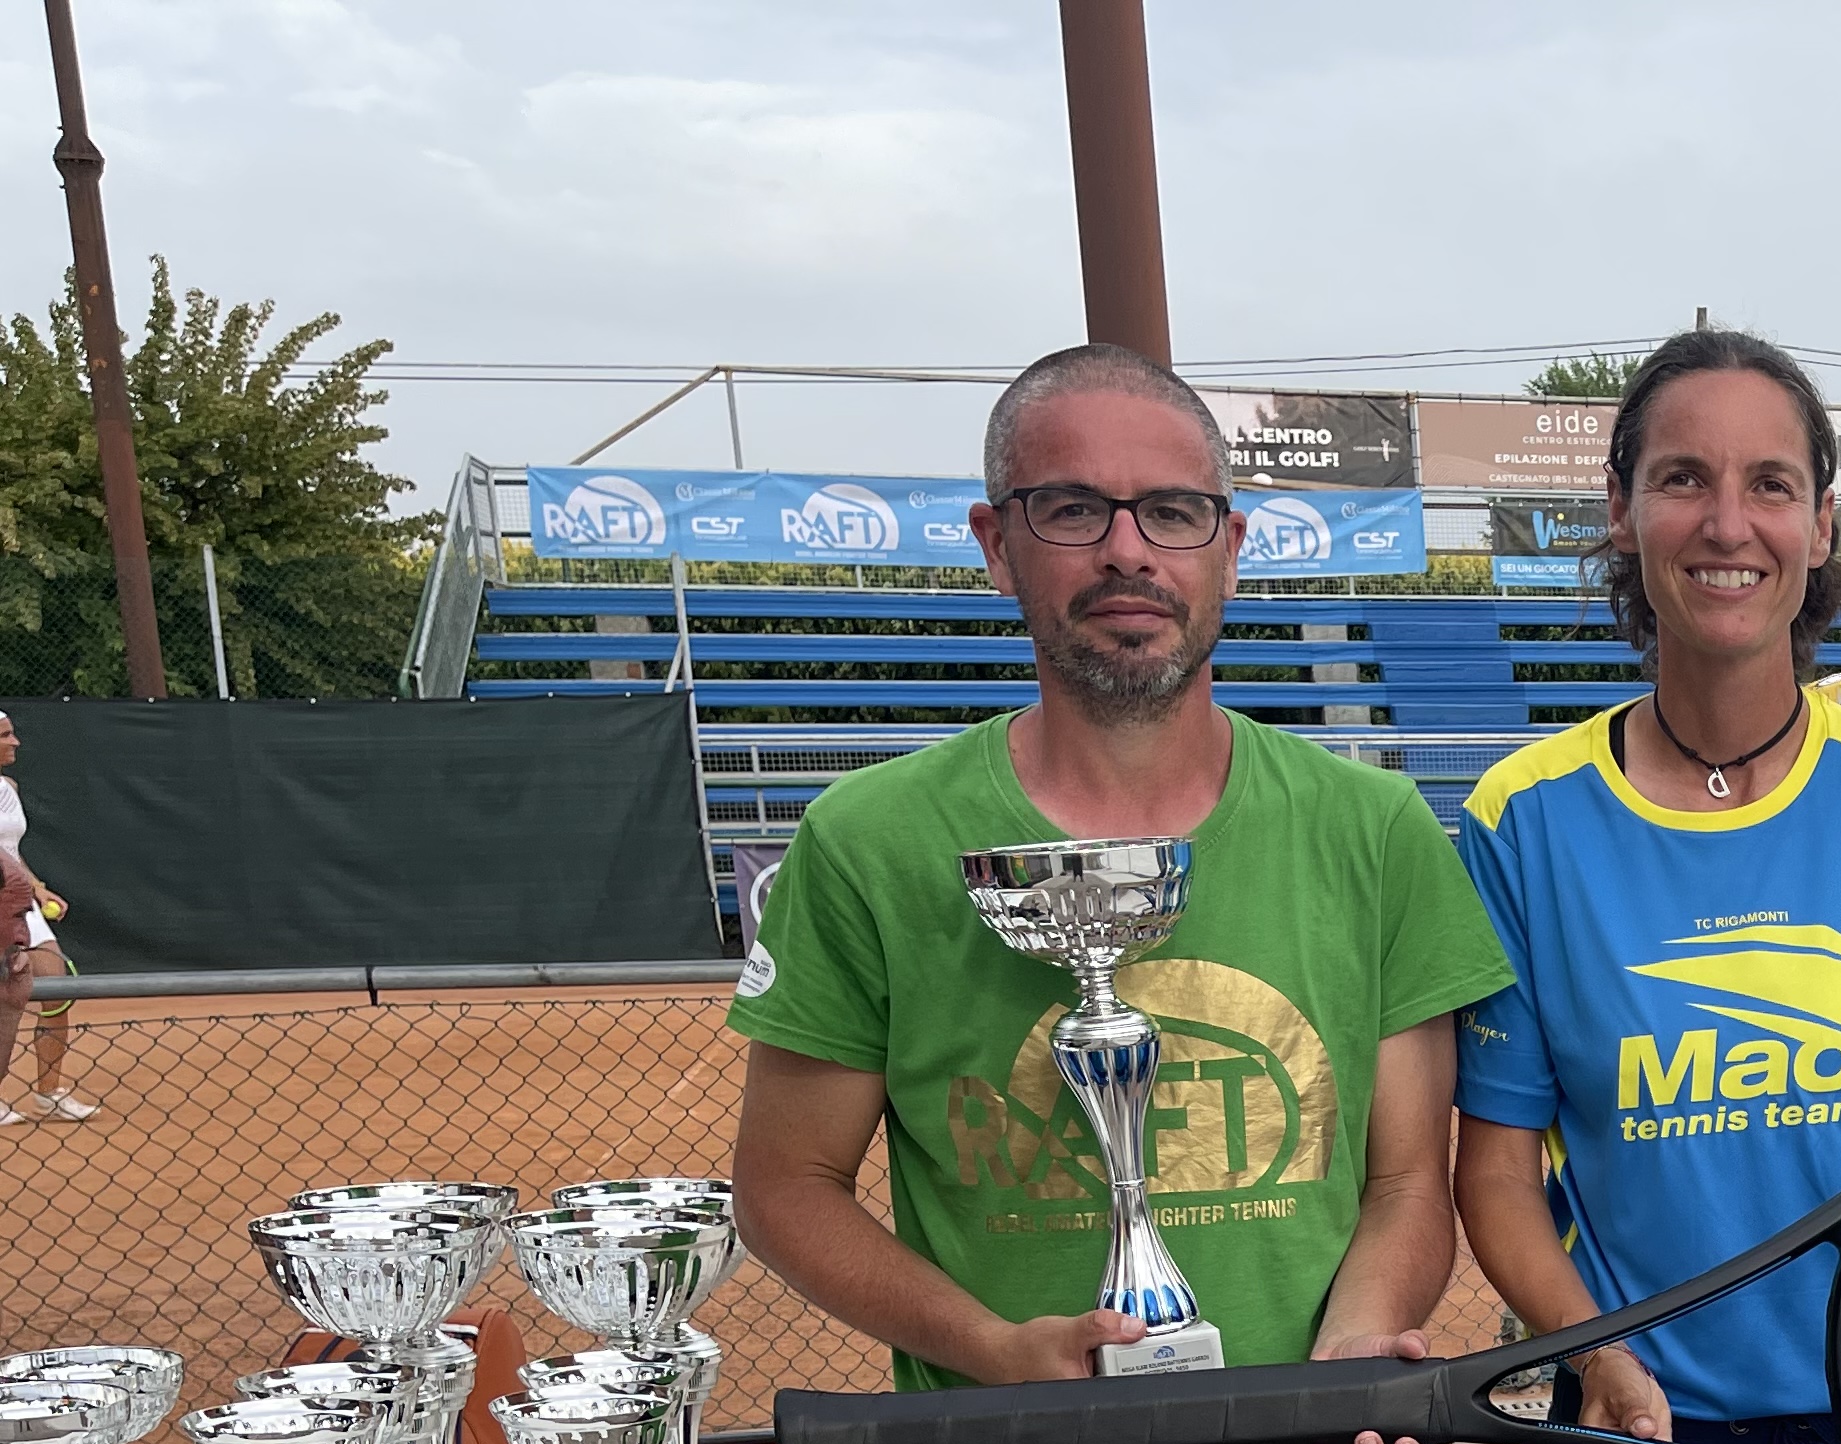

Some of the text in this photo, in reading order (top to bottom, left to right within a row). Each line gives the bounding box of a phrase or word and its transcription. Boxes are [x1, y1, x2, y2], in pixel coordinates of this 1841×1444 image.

[1536, 410, 1599, 434] eide
[1251, 427, 1333, 445] CENTRO
[1522, 436, 1564, 445] CENTRO
[1229, 449, 1340, 468] RI IL GOLF!
[1494, 453, 1611, 466] EPILAZIONE DEFIN
[1488, 473, 1550, 484] CASTEGNATO
[1551, 474, 1571, 485] (BS)
[543, 503, 643, 541] RAFT
[691, 516, 745, 535] CST
[781, 508, 878, 545] RAFT
[1240, 524, 1314, 558] AFT
[1352, 531, 1400, 549] CST
[1500, 563, 1580, 574] SEI UN GIOCATO
[1694, 910, 1790, 930] TC RIGAMONTI
[1620, 1105, 1750, 1142] tennis
[1044, 1211, 1113, 1233] AMATE
[1153, 1204, 1225, 1228] IGHTER
[1230, 1197, 1298, 1222] TENNIS
